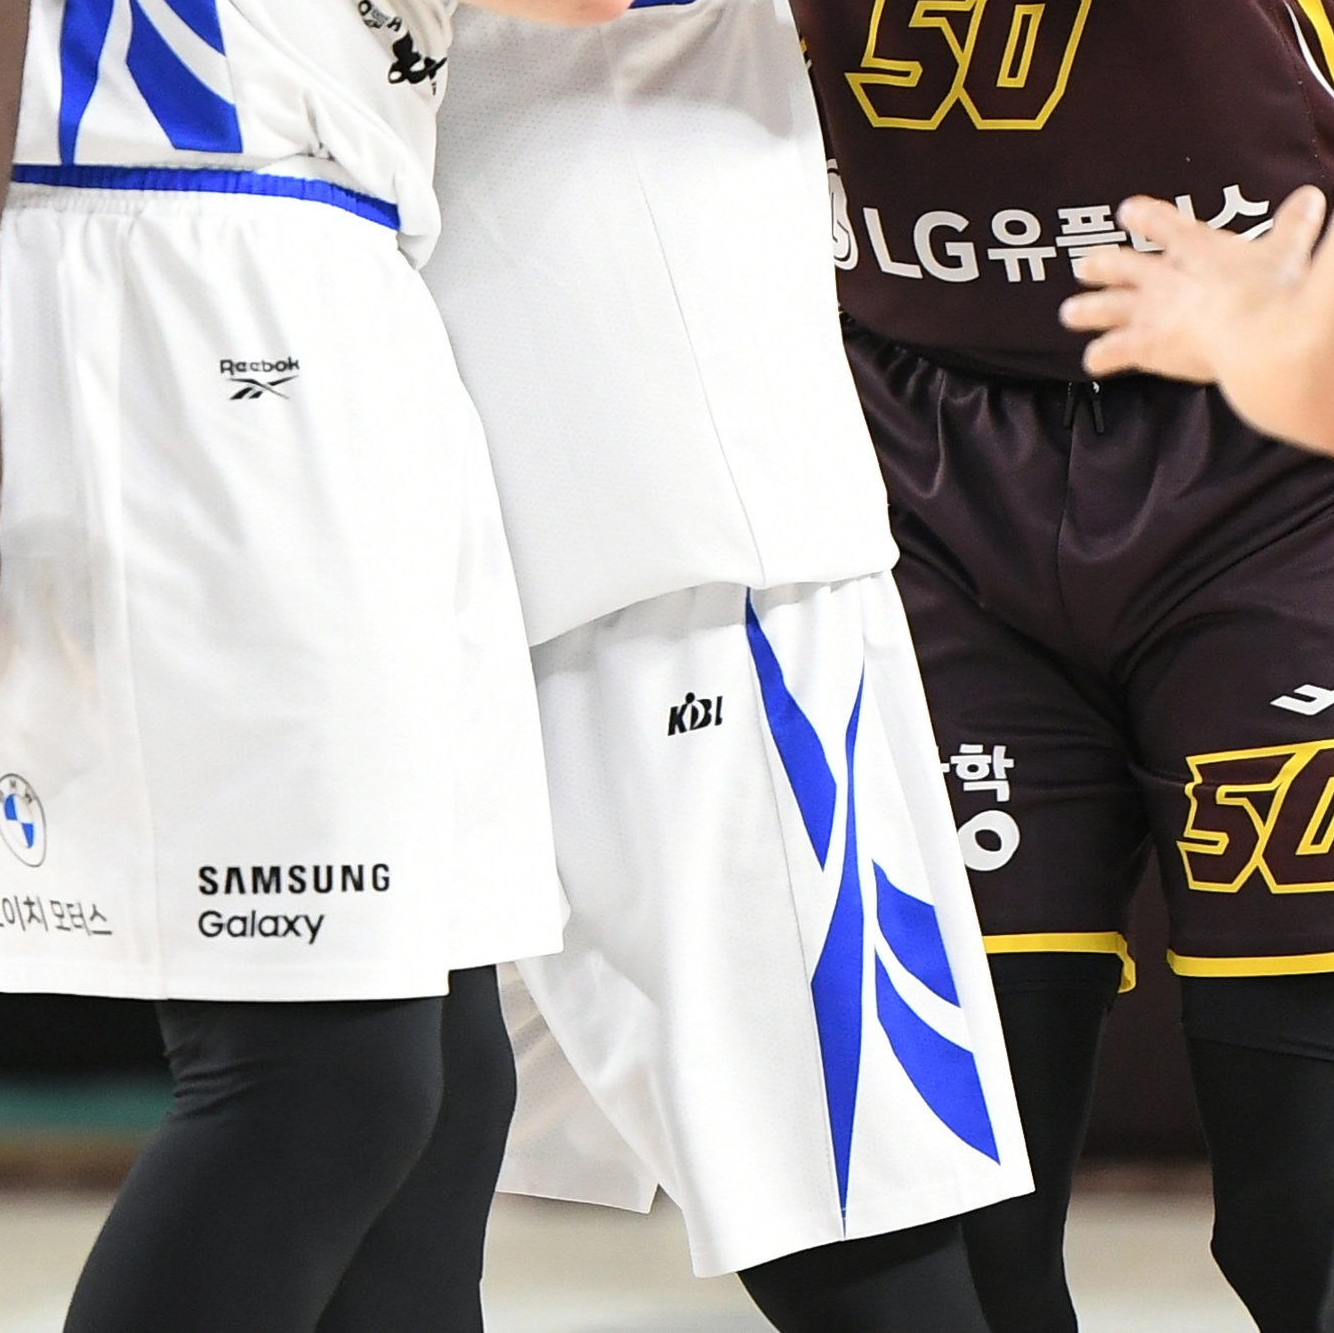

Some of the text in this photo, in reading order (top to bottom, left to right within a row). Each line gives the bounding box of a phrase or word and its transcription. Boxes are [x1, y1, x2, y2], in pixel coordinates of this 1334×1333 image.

[862, 183, 1275, 284] LG유플스
[219, 356, 300, 377] Reebok
[667, 692, 723, 736] KBL
[199, 863, 391, 896] SAMSUNG
[54, 898, 113, 936] 모터스
[199, 910, 324, 945] Galaxy
